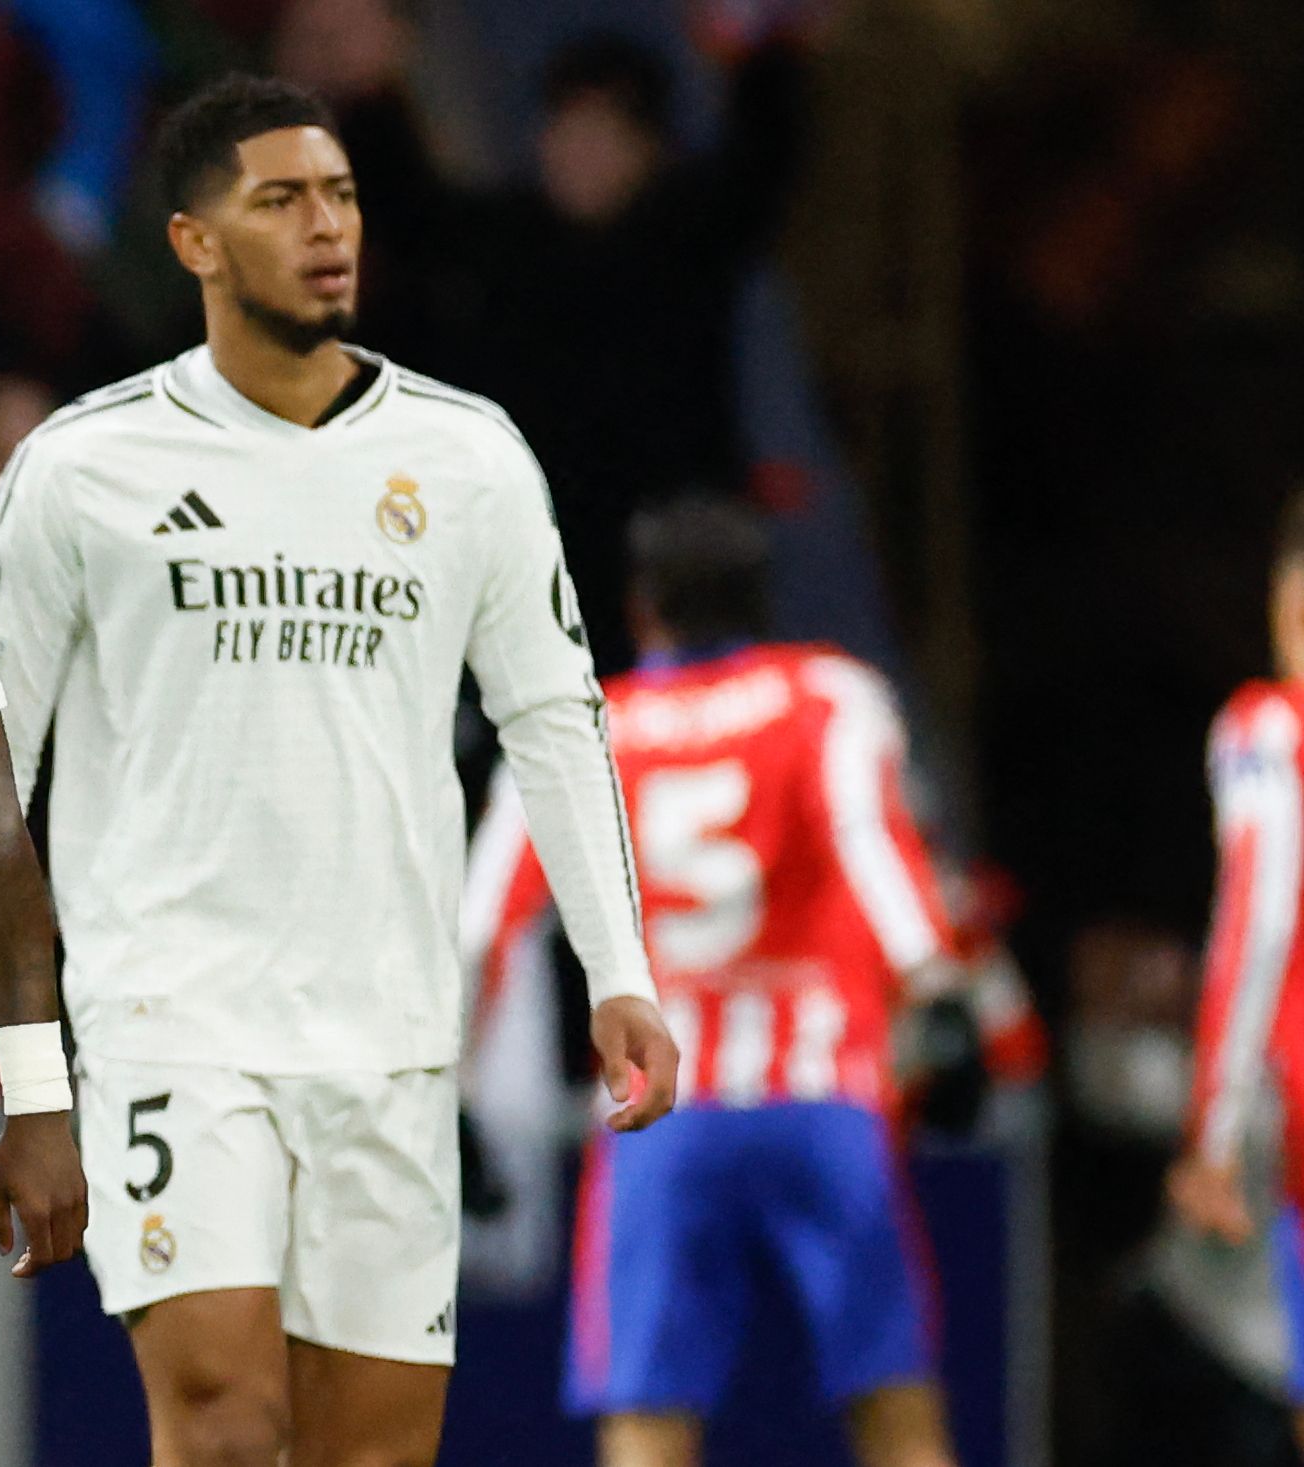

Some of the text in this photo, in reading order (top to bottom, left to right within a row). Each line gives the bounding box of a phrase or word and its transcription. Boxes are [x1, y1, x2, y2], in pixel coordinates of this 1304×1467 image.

[167, 552, 425, 621] Emirates
[214, 619, 384, 669] FLY BETTER
[125, 1089, 173, 1202] 5
